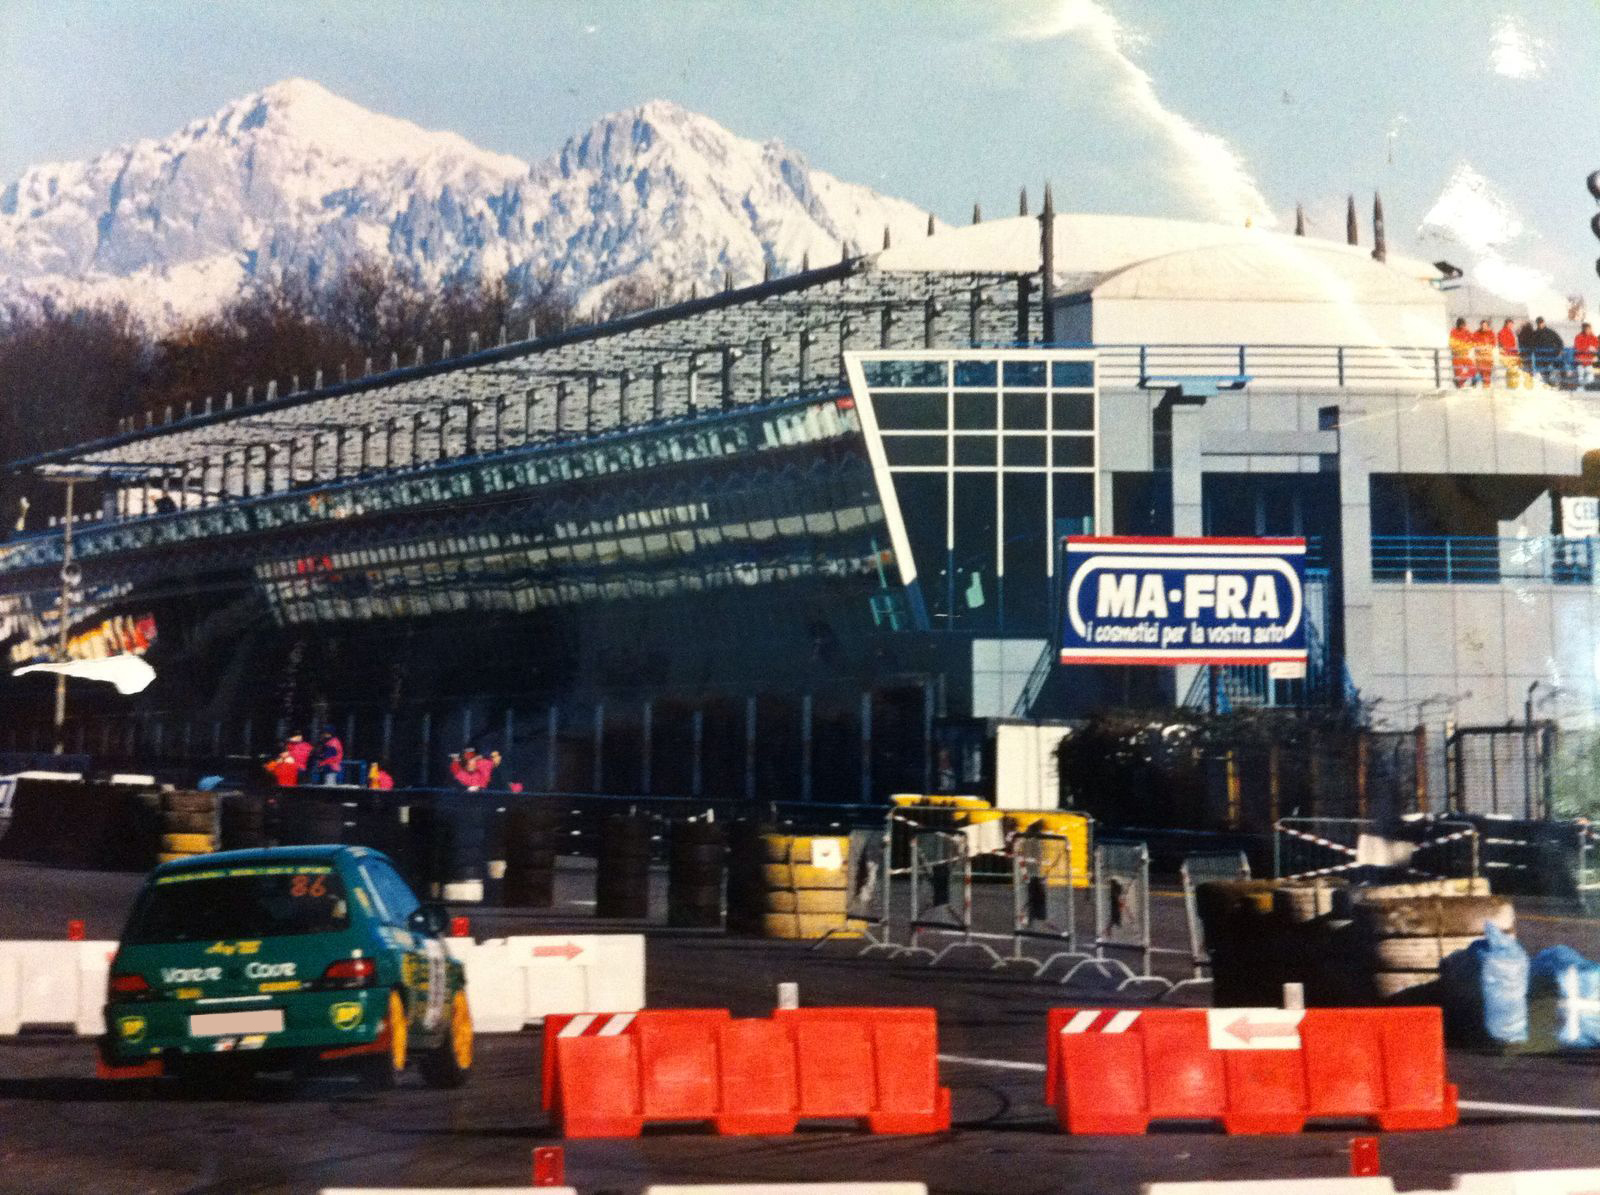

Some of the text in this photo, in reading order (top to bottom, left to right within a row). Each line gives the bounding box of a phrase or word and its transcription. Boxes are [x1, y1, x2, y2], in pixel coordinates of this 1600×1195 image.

[1161, 626, 1187, 649] per
[1190, 621, 1205, 644] la
[1207, 622, 1251, 644] vostra
[1253, 622, 1286, 644] auto
[290, 874, 327, 897] 86
